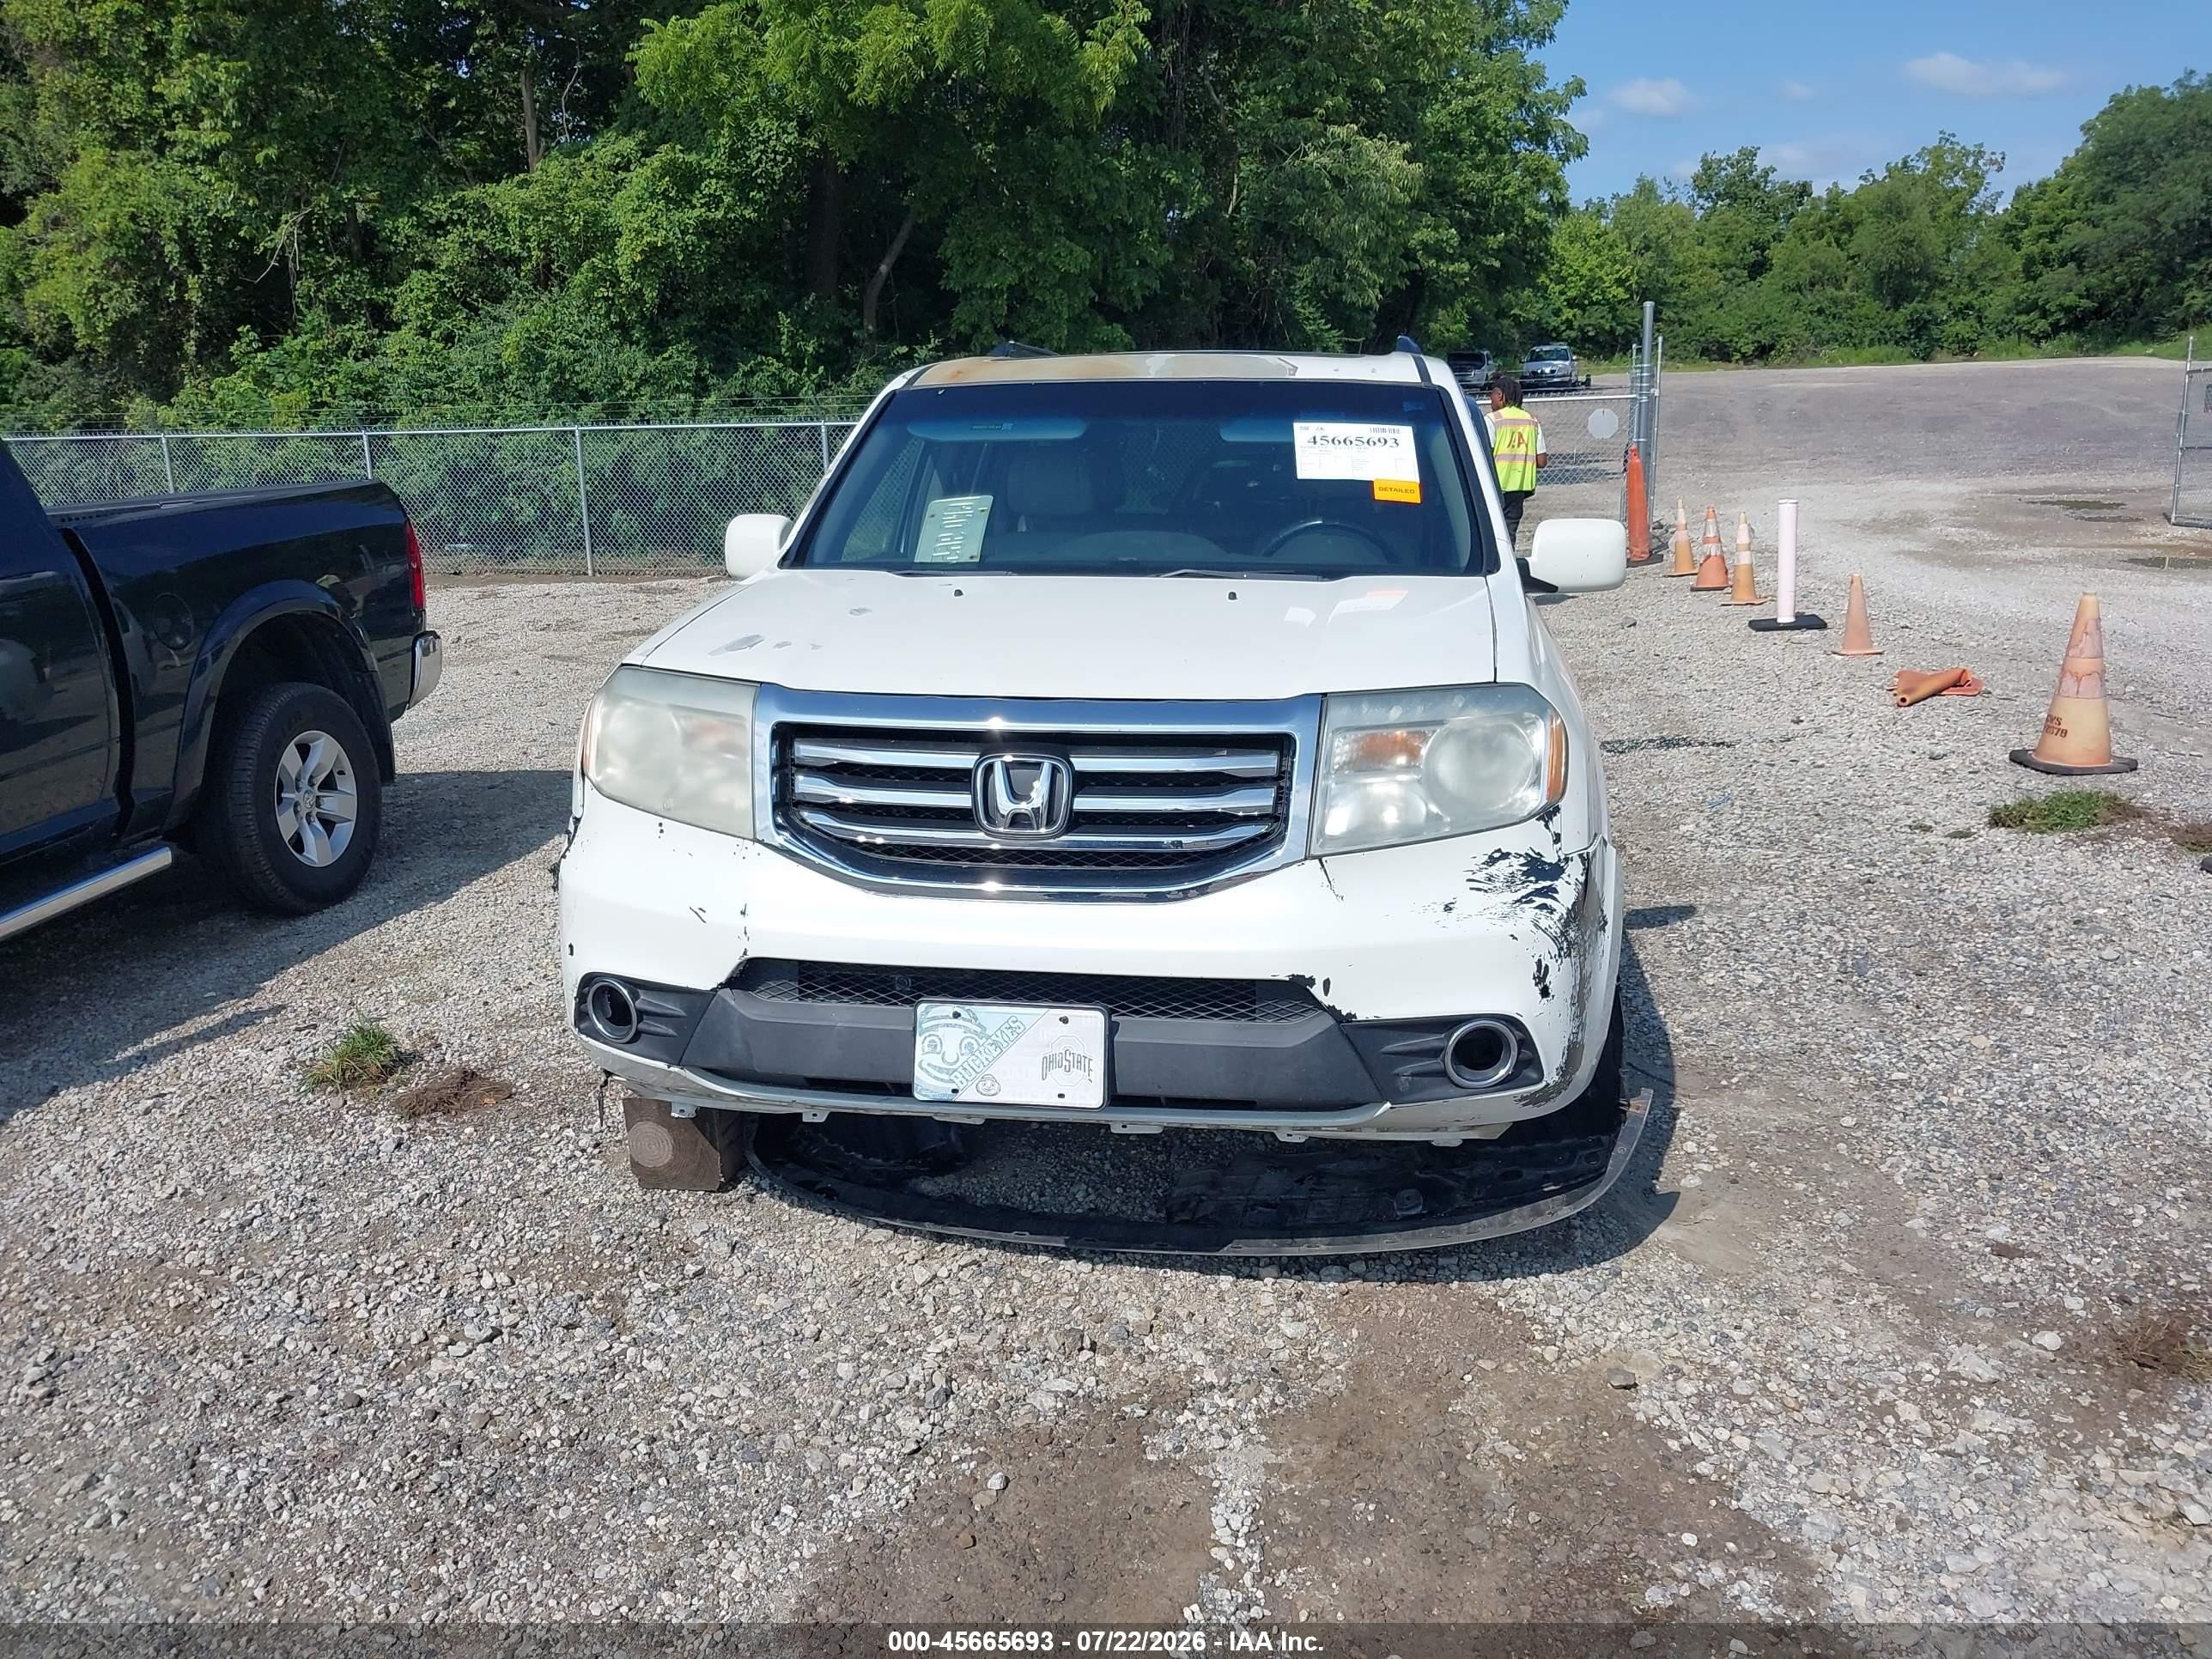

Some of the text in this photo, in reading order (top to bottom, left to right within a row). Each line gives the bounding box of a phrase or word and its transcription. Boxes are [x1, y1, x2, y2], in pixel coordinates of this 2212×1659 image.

[1307, 434, 1401, 448] 45665693
[1377, 486, 1416, 495] DETAILED
[949, 1016, 1027, 1089] BUCKEYES
